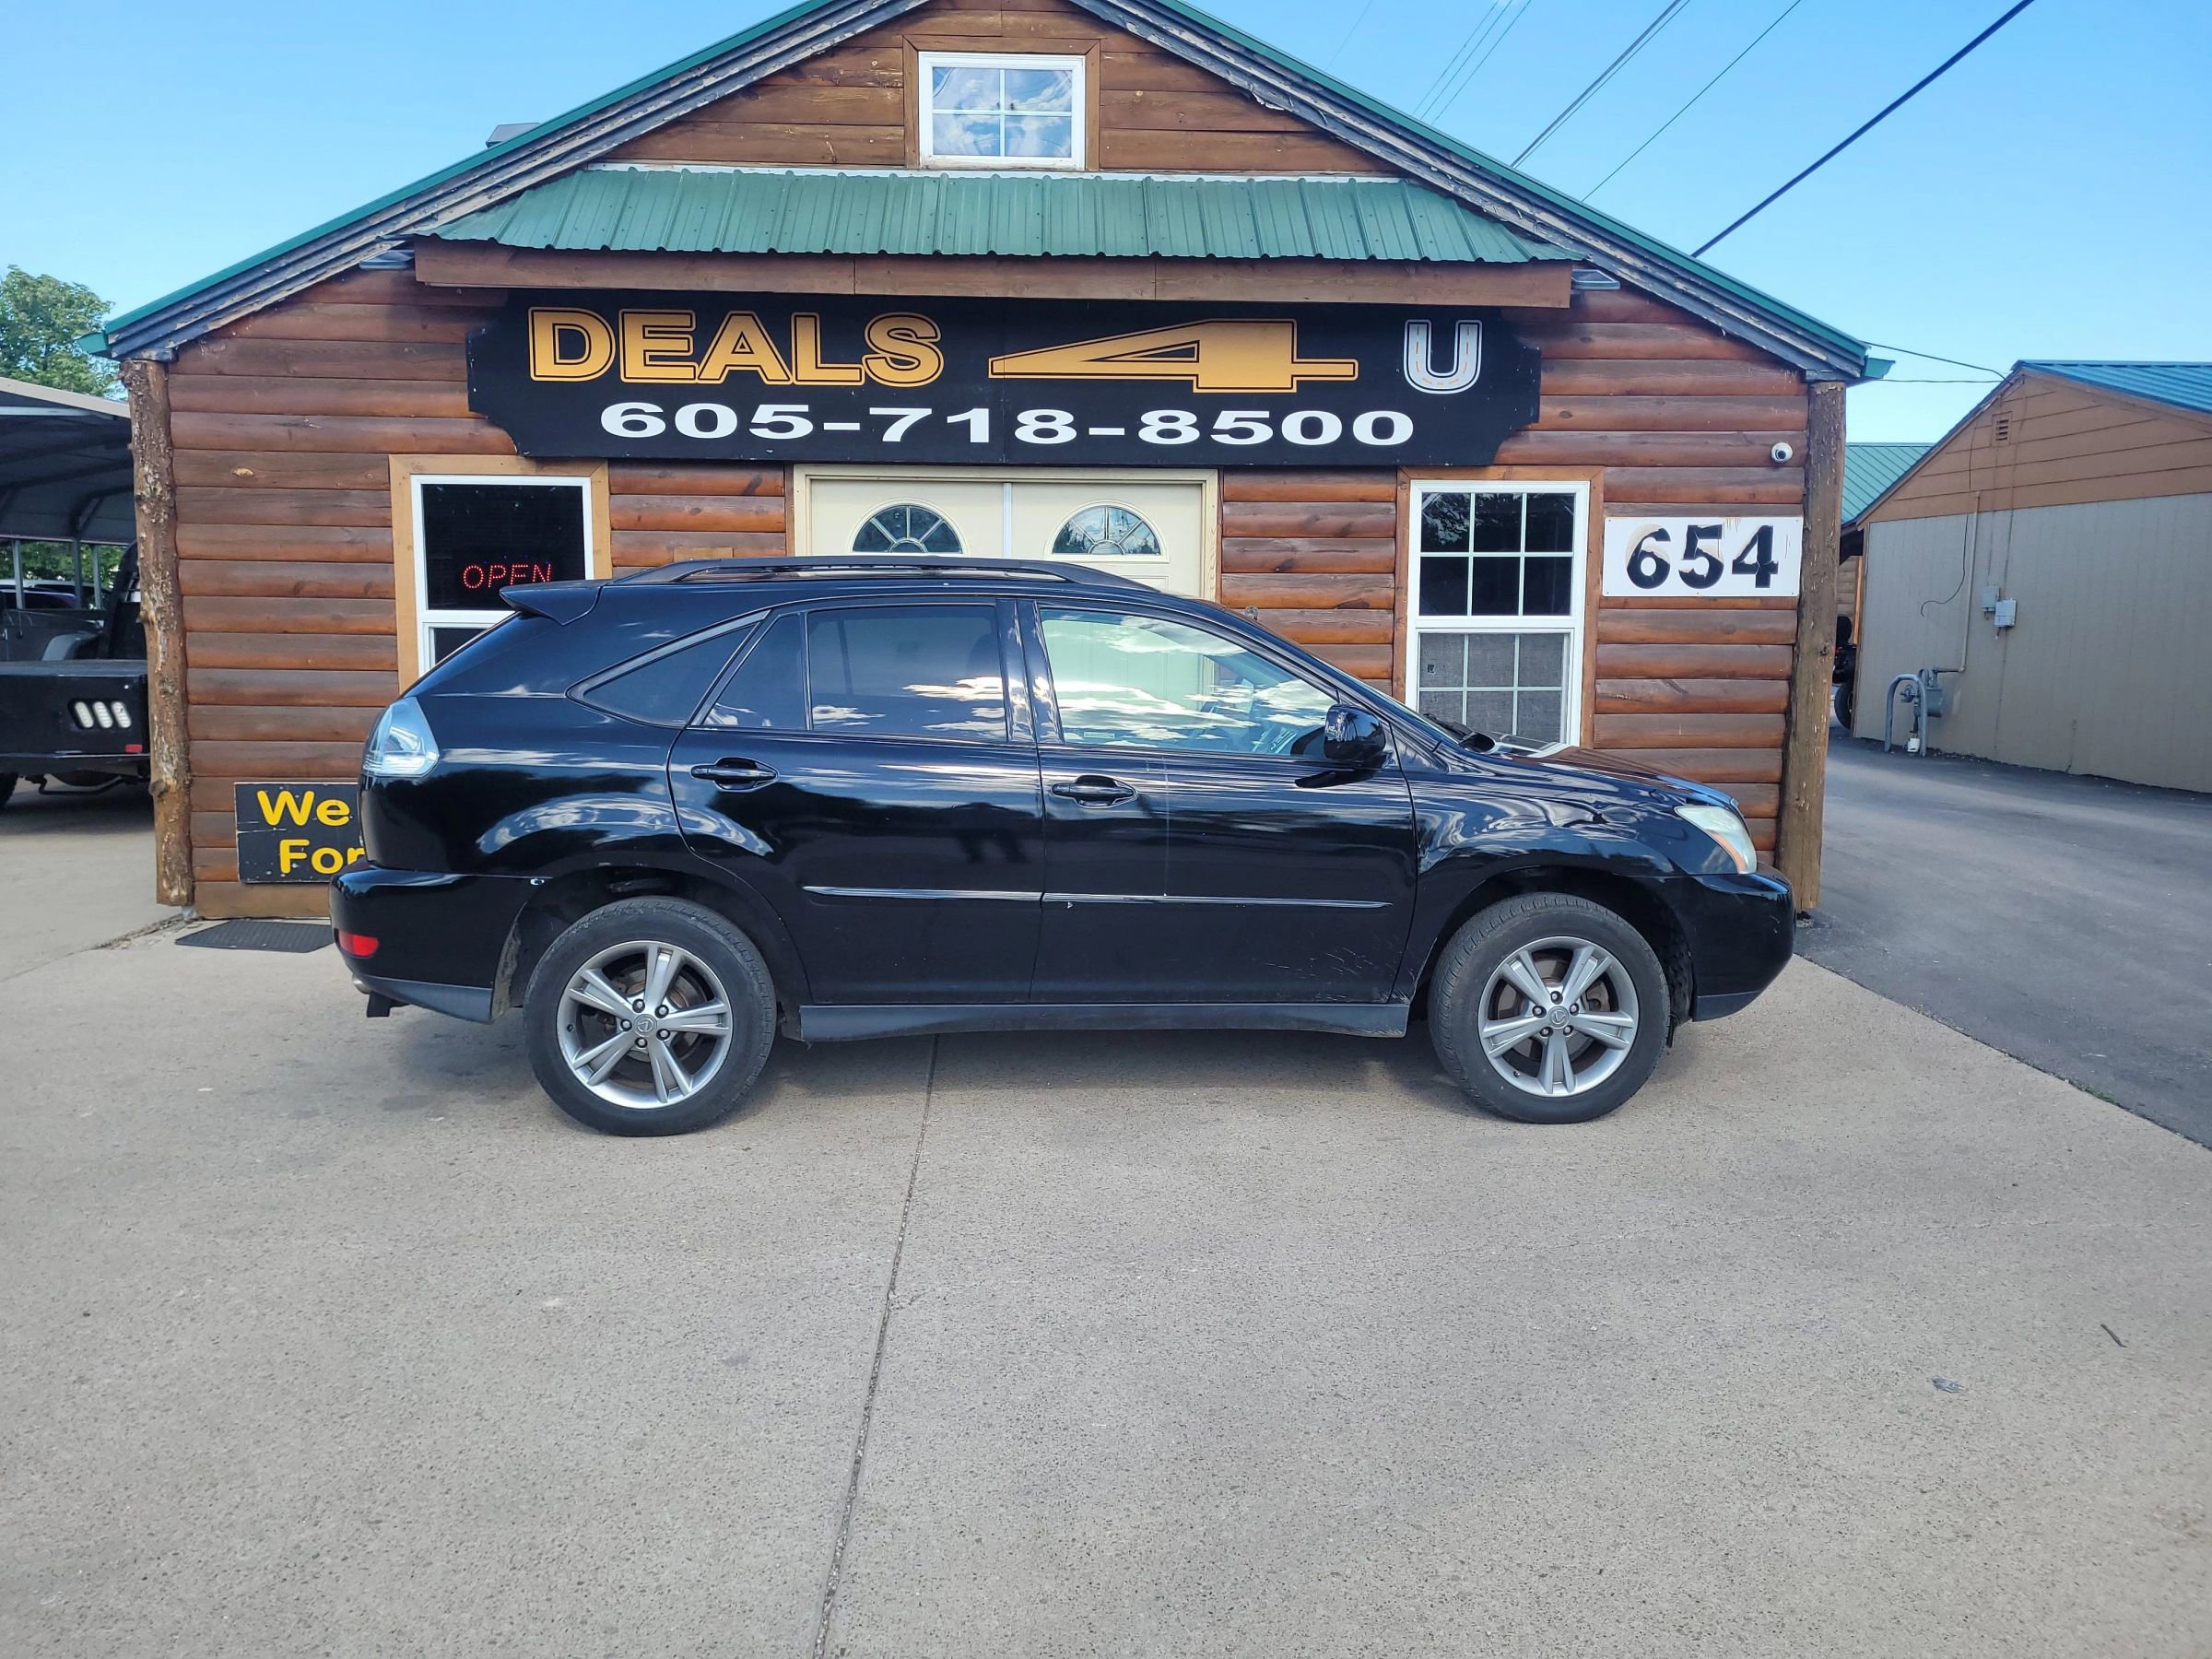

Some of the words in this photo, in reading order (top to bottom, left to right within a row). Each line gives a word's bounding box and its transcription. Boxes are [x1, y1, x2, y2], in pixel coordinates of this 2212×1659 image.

[528, 307, 945, 387] DEALS
[988, 319, 1359, 393] 4
[1404, 319, 1482, 394] U
[600, 402, 1414, 446] 605-718-8500
[463, 563, 552, 589] OPEN
[1625, 524, 1779, 590] 654
[256, 790, 350, 826] We
